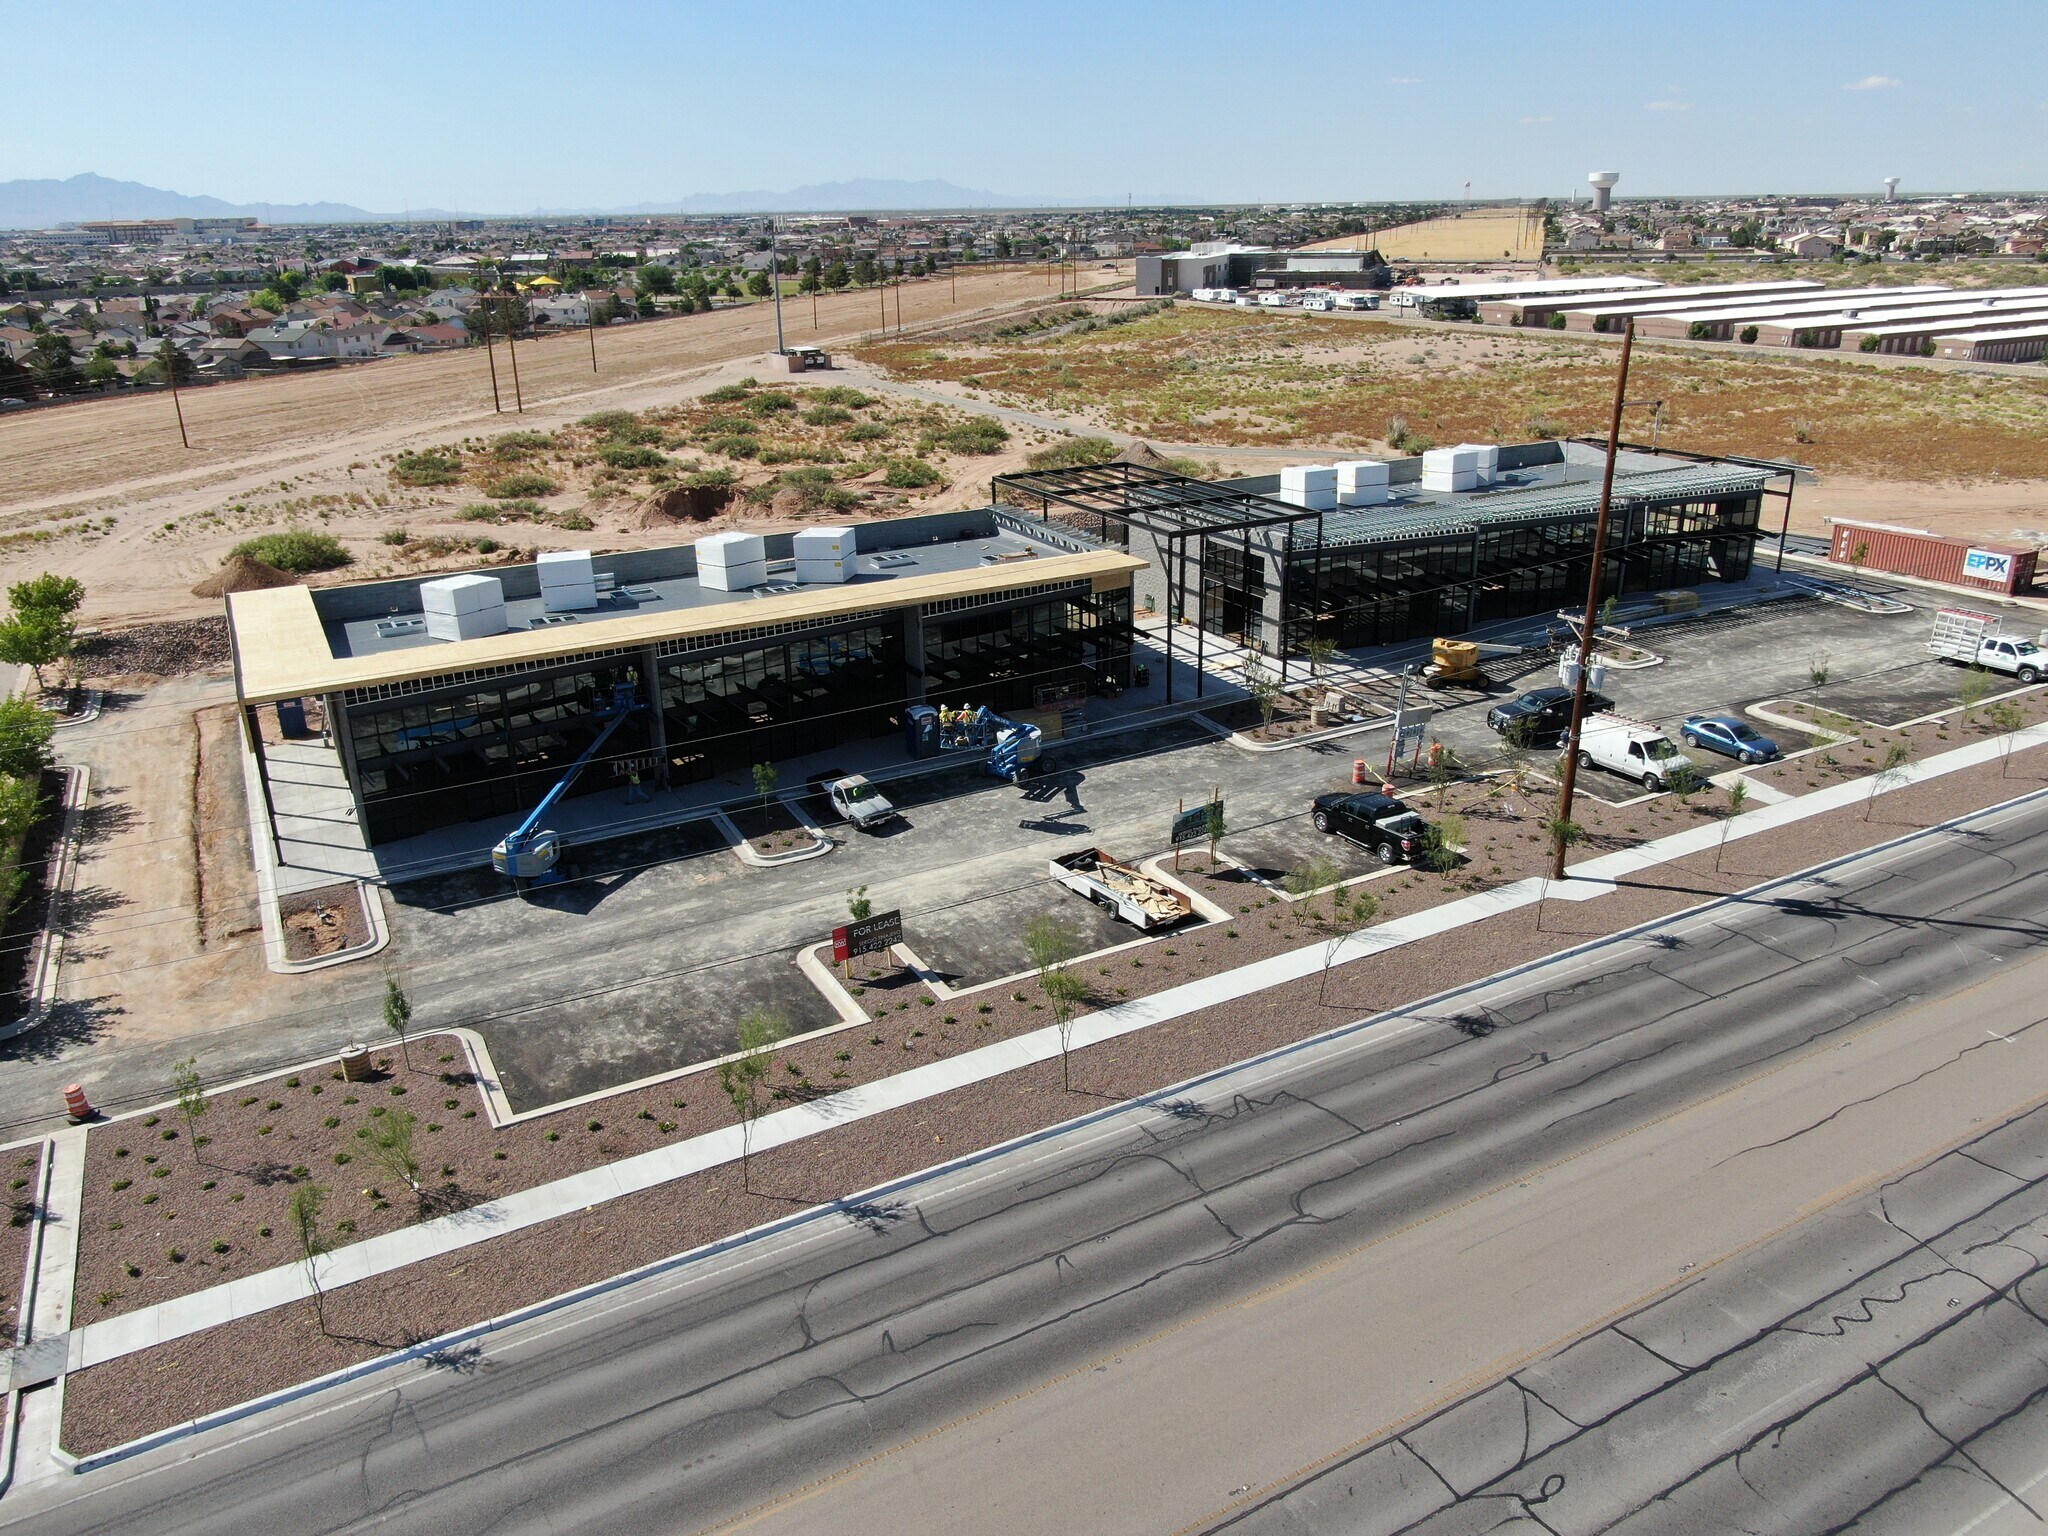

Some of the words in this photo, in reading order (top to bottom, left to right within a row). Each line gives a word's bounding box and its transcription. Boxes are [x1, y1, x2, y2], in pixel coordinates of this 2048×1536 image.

[1967, 553, 2007, 573] EPPX
[853, 925, 871, 937] FOR
[873, 917, 900, 931] LEASE
